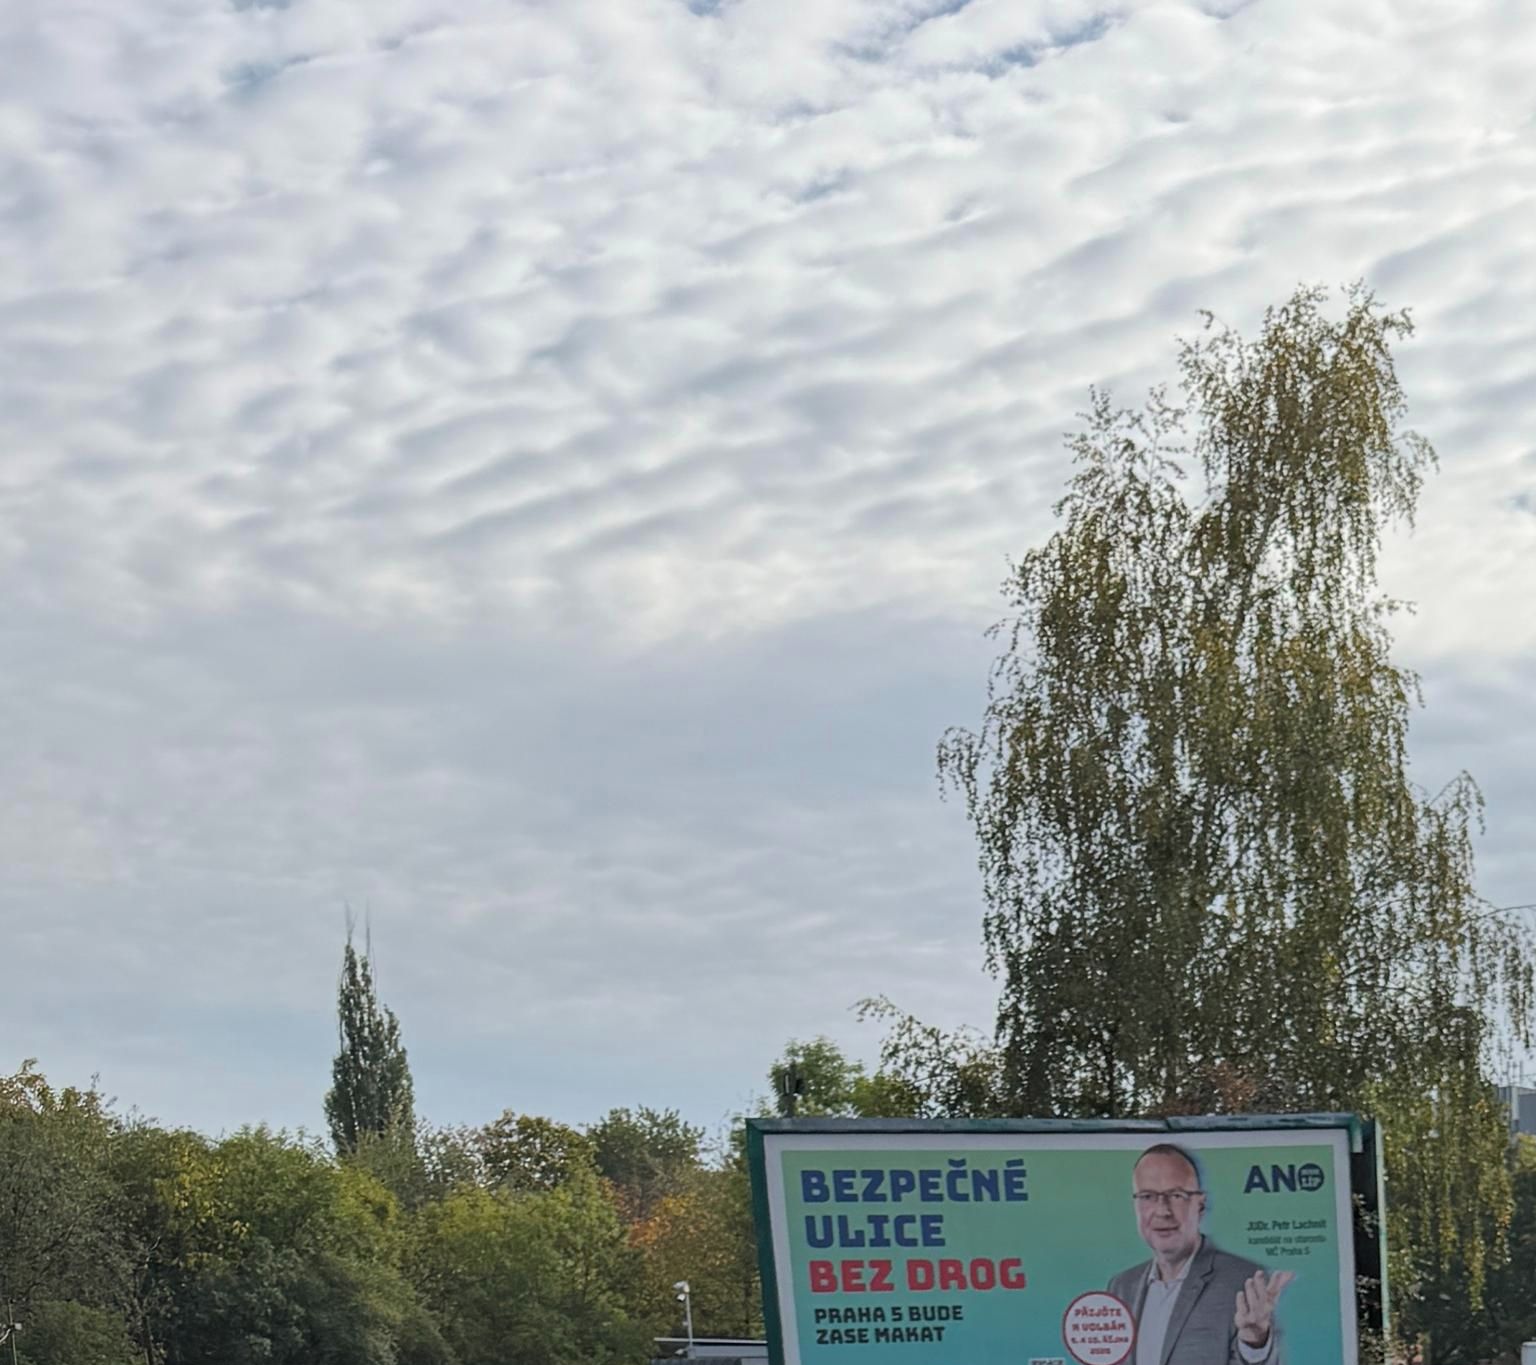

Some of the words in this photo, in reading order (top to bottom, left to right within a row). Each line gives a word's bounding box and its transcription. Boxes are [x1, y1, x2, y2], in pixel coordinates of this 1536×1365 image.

[801, 1158, 1029, 1202] BEZPEČNÉ
[805, 1214, 946, 1248] ULICE
[809, 1260, 895, 1292] BEZ
[906, 1258, 1027, 1291] DROG
[814, 1307, 886, 1324] PRAHA
[891, 1306, 903, 1322] 5
[909, 1305, 964, 1321] BUDE
[816, 1328, 869, 1344] ZASE
[875, 1326, 945, 1343] MAKAT
